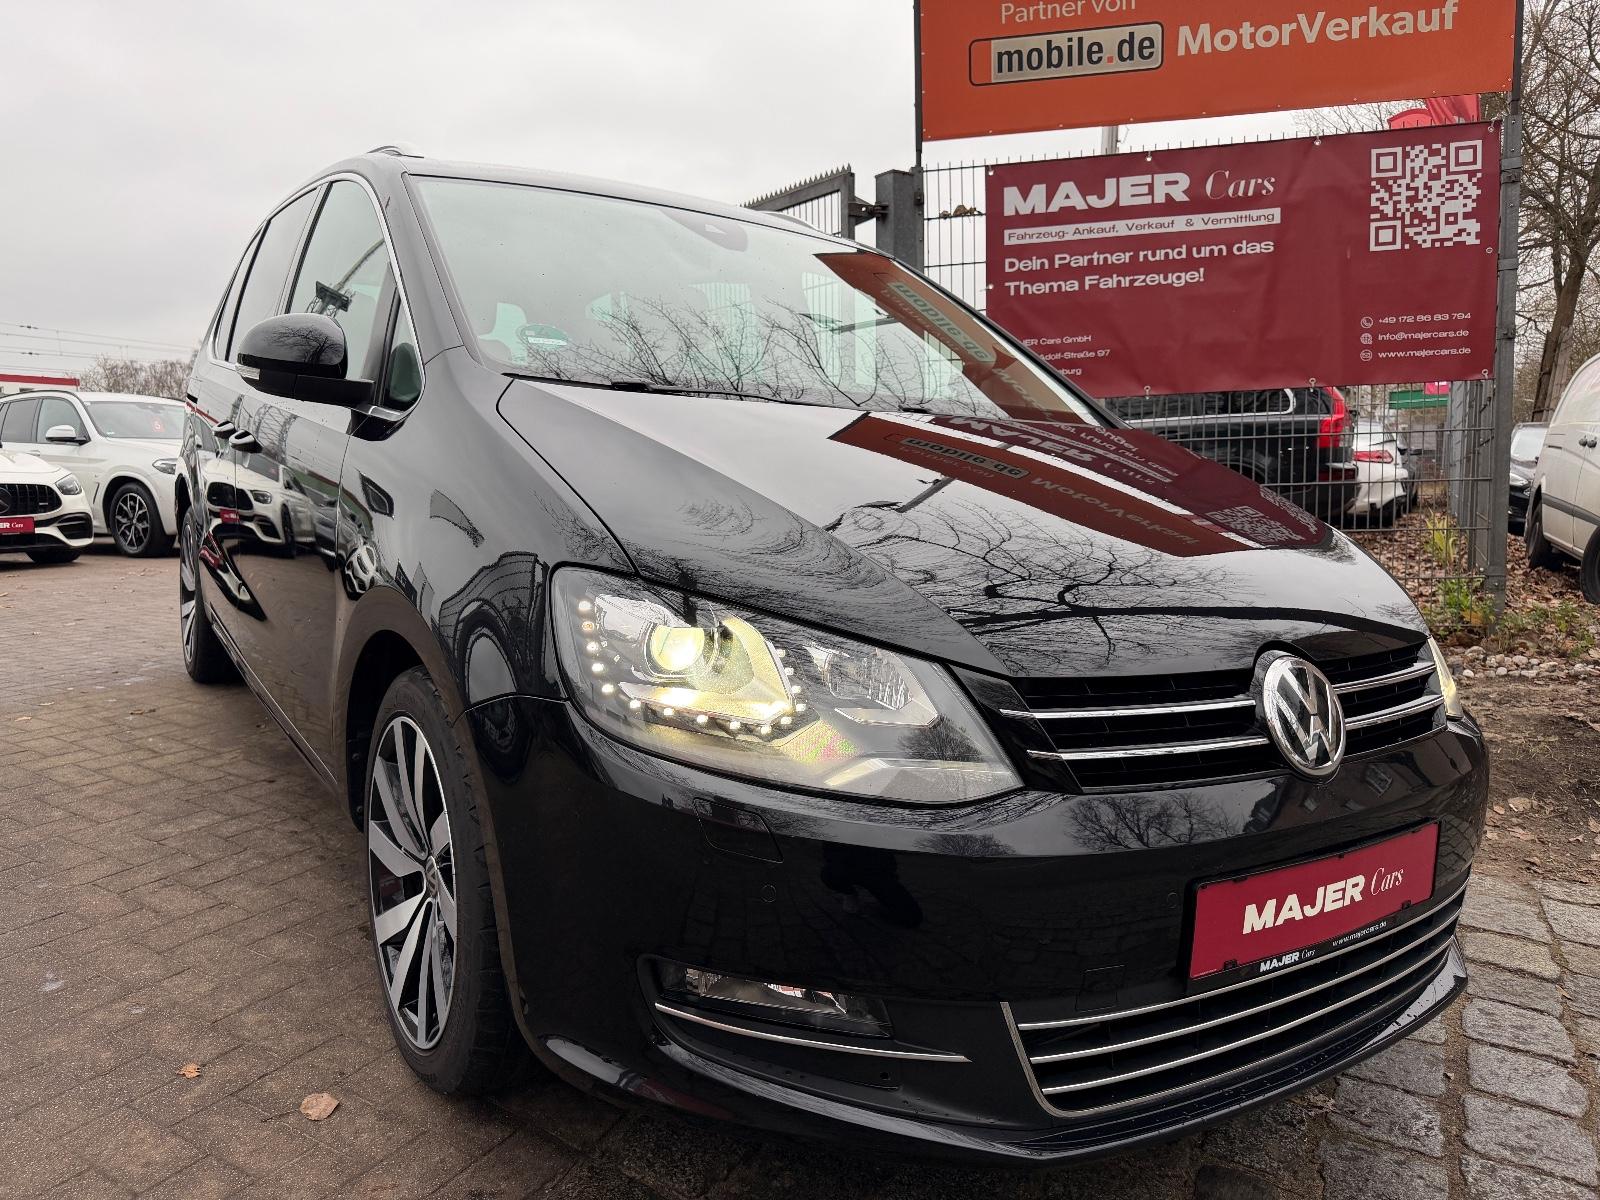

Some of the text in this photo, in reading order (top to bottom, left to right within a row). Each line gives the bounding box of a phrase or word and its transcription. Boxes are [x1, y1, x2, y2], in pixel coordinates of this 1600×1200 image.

[1000, 0, 1136, 24] Partner von
[1177, 0, 1458, 56] MotorVerkauf
[997, 32, 1155, 73] mobile.de
[1003, 170, 1276, 216] MAJER Cars
[1008, 230, 1069, 242] Fahrzeug-
[1126, 219, 1175, 232] Verkauf
[1185, 218, 1194, 227] &
[1201, 213, 1275, 226] Vermittlung
[1004, 239, 1274, 273] Dein Partner rund um das
[1005, 267, 1205, 296] Thema Fahrzeuge!
[1379, 316, 1396, 324] +49
[1451, 312, 1471, 320] 794
[1040, 337, 1061, 345] Cars
[1063, 335, 1092, 344] GmbH
[1378, 329, 1469, 341] info@majercars.de
[1097, 349, 1110, 357] 97
[1378, 346, 1471, 358] www.majercars.de
[1242, 866, 1404, 935] MAJER Cars
[1259, 951, 1300, 973] MAJER
[1301, 949, 1316, 960] Cars
